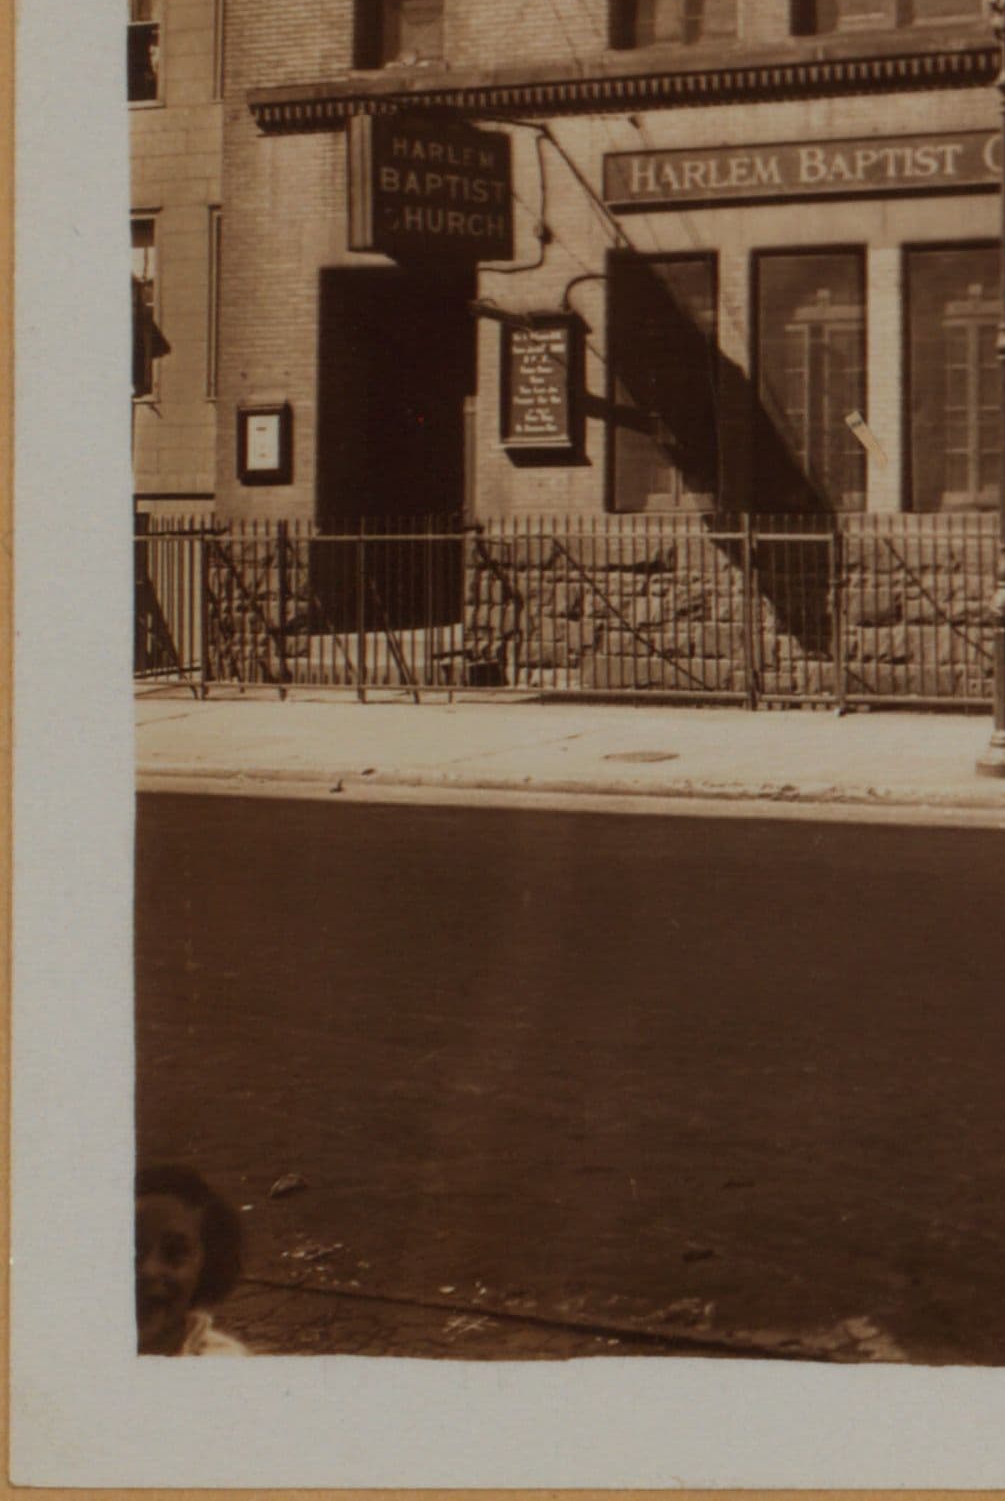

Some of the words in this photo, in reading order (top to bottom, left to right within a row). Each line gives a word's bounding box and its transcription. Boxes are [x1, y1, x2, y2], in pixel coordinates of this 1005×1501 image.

[379, 166, 506, 203] BAPTIST
[630, 155, 783, 193] HARLEM
[799, 144, 962, 184] BAPTIST
